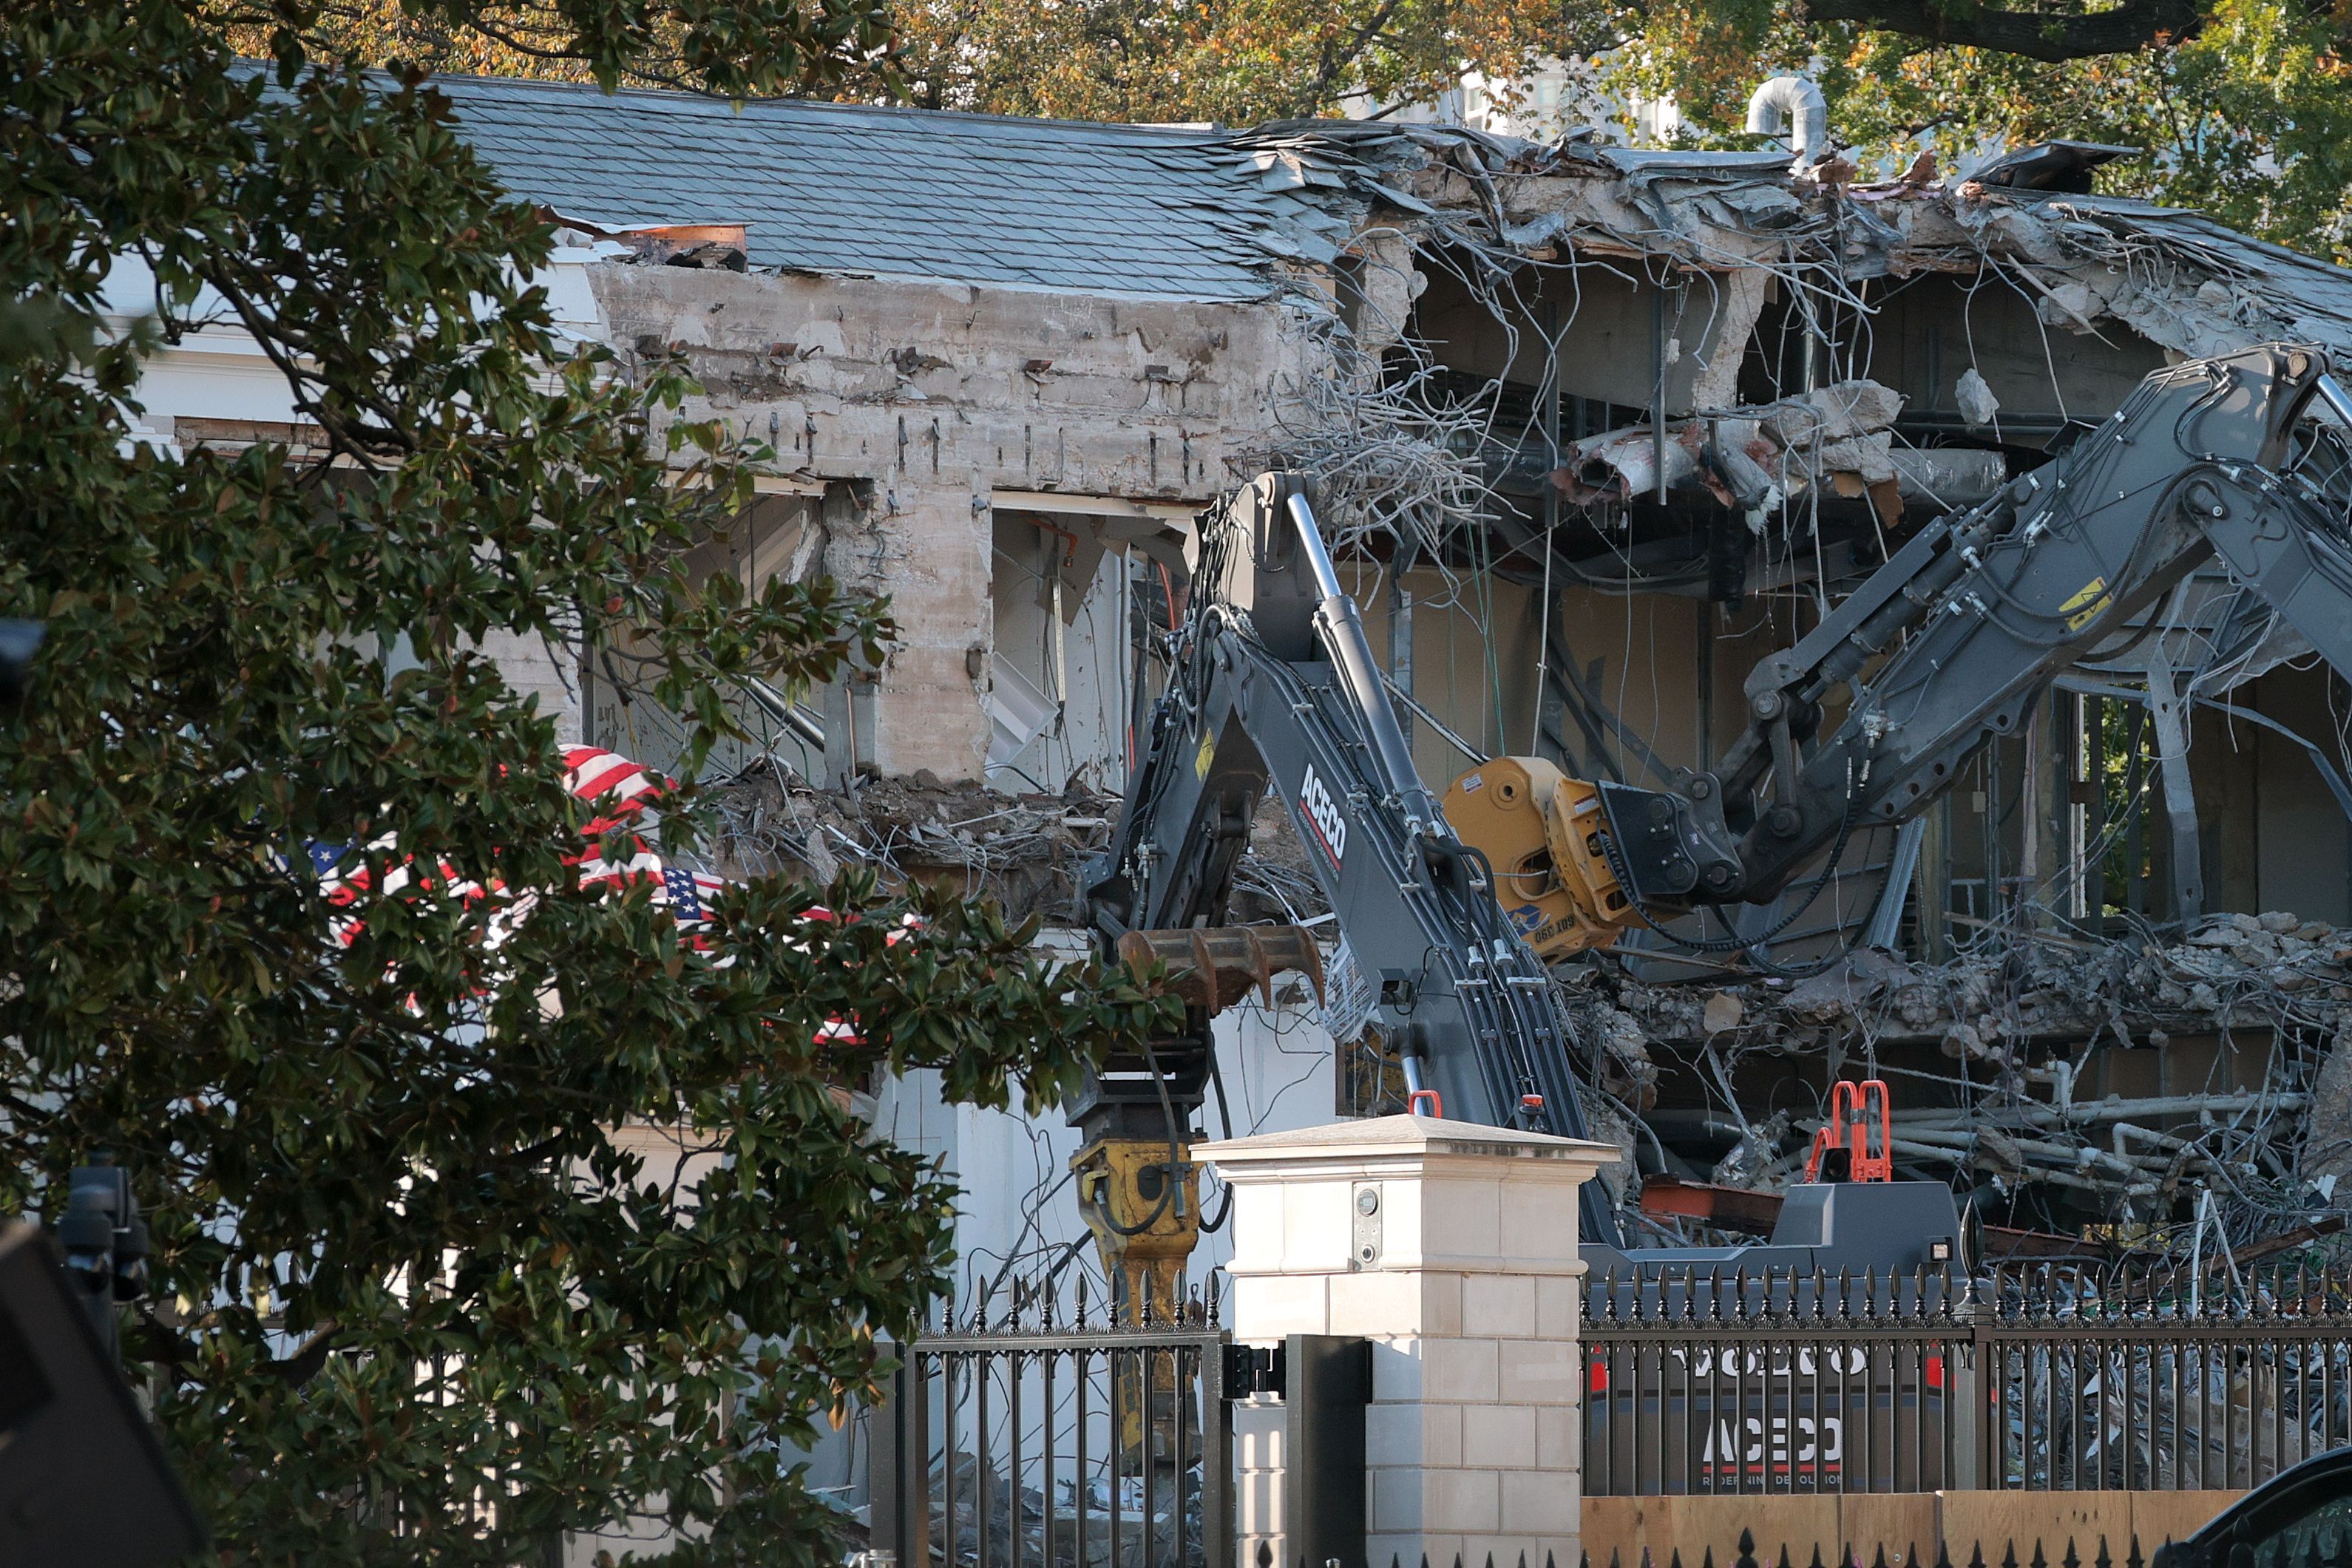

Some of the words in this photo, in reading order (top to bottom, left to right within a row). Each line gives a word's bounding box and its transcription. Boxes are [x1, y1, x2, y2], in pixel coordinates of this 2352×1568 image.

[1301, 763, 1346, 860] ACECO
[1672, 1348, 1865, 1377] VOLVO
[1703, 1418, 1841, 1462] ACECO
